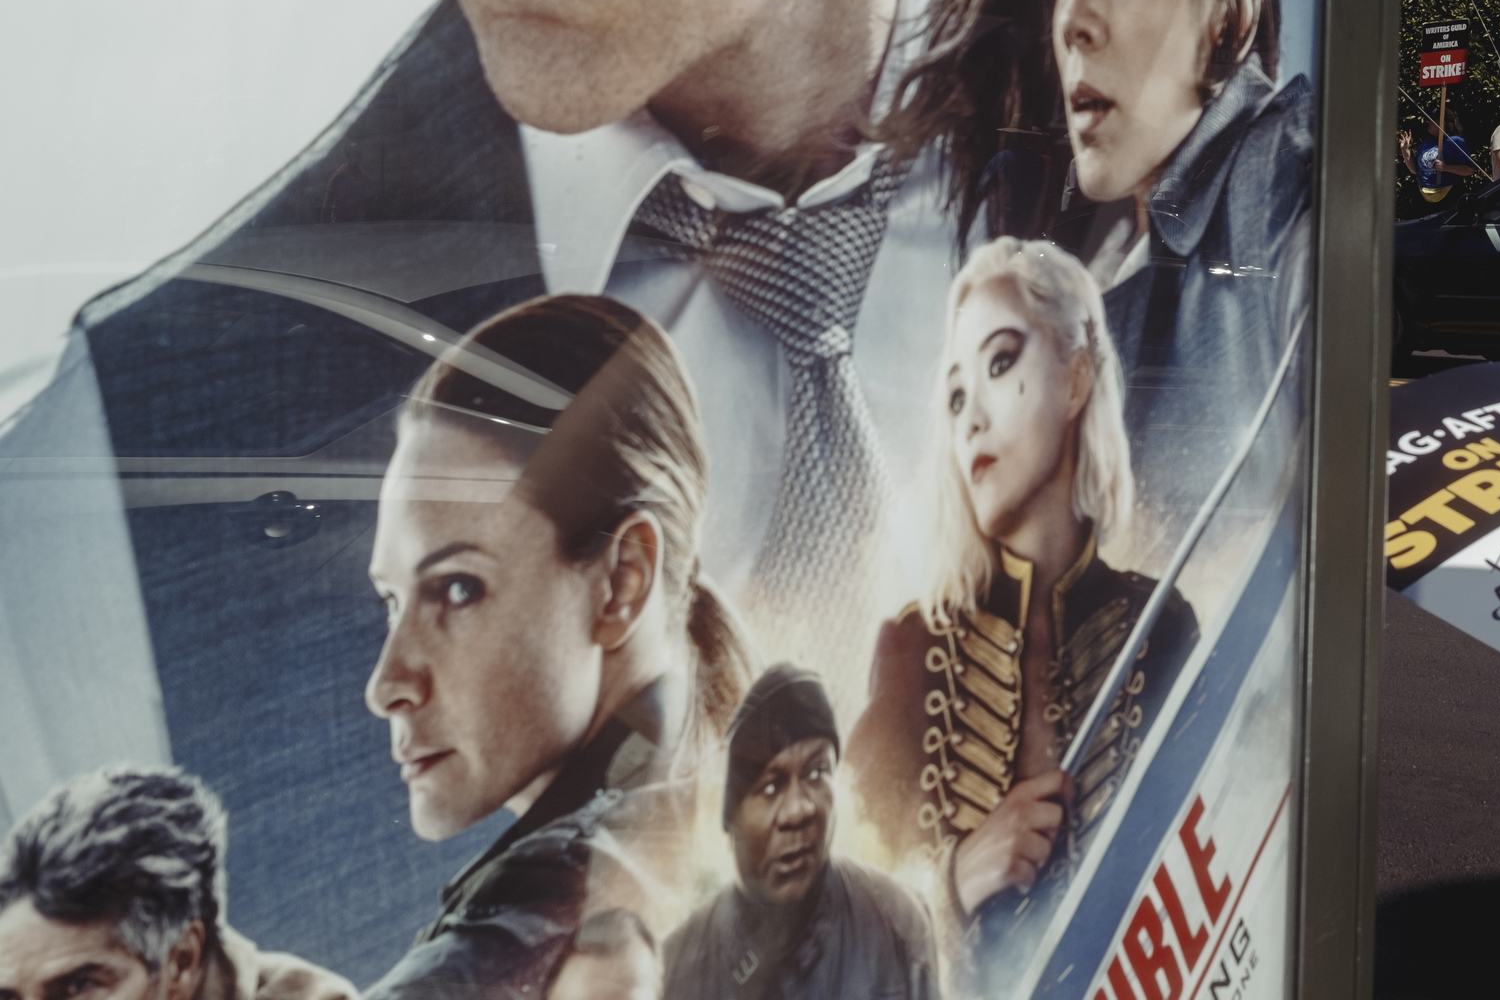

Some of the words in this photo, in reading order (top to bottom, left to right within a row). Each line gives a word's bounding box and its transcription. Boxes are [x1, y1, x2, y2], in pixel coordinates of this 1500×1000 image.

[1425, 25, 1450, 35] WRITERS
[1450, 23, 1467, 32] GUILD
[1432, 40, 1459, 50] AMERICA
[1440, 54, 1451, 63] ON
[1422, 61, 1466, 80] STRIKE!
